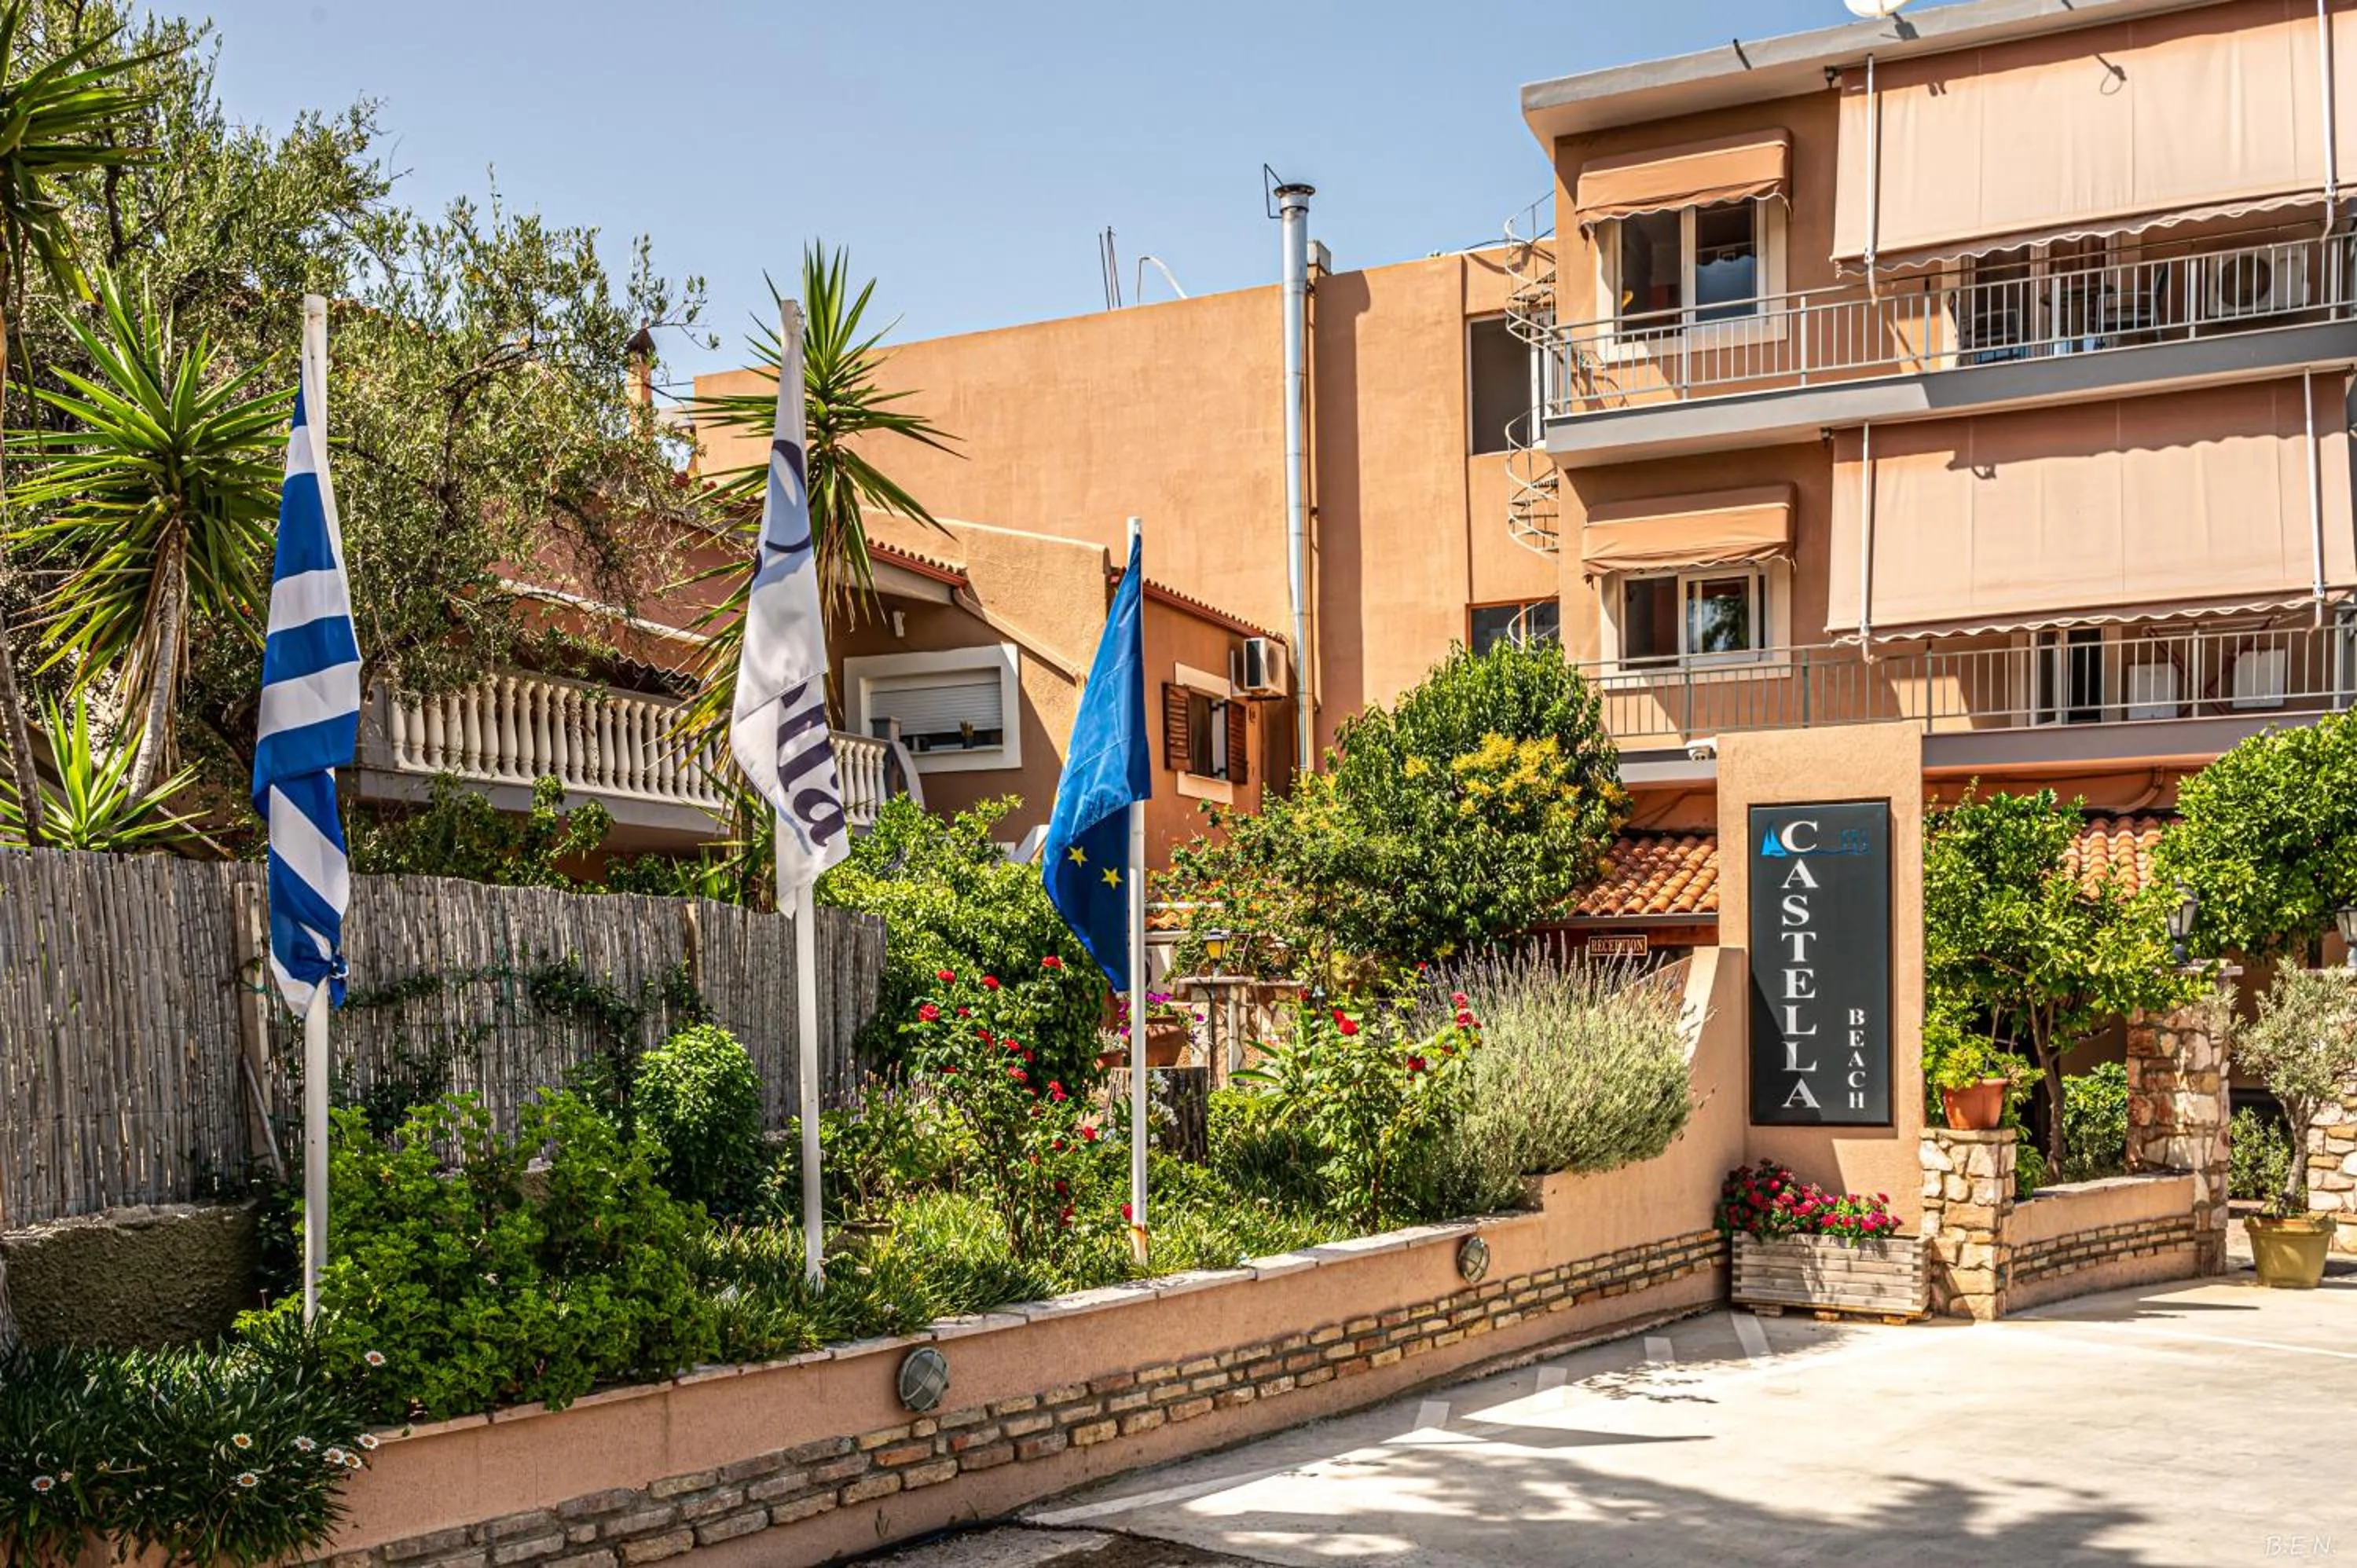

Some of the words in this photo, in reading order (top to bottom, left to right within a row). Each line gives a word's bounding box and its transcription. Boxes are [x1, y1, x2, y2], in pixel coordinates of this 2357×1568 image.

[1591, 938, 1644, 953] RECEPTION
[1779, 820, 1820, 1108] CASTELLA
[1848, 1009, 1866, 1108] BEACH
